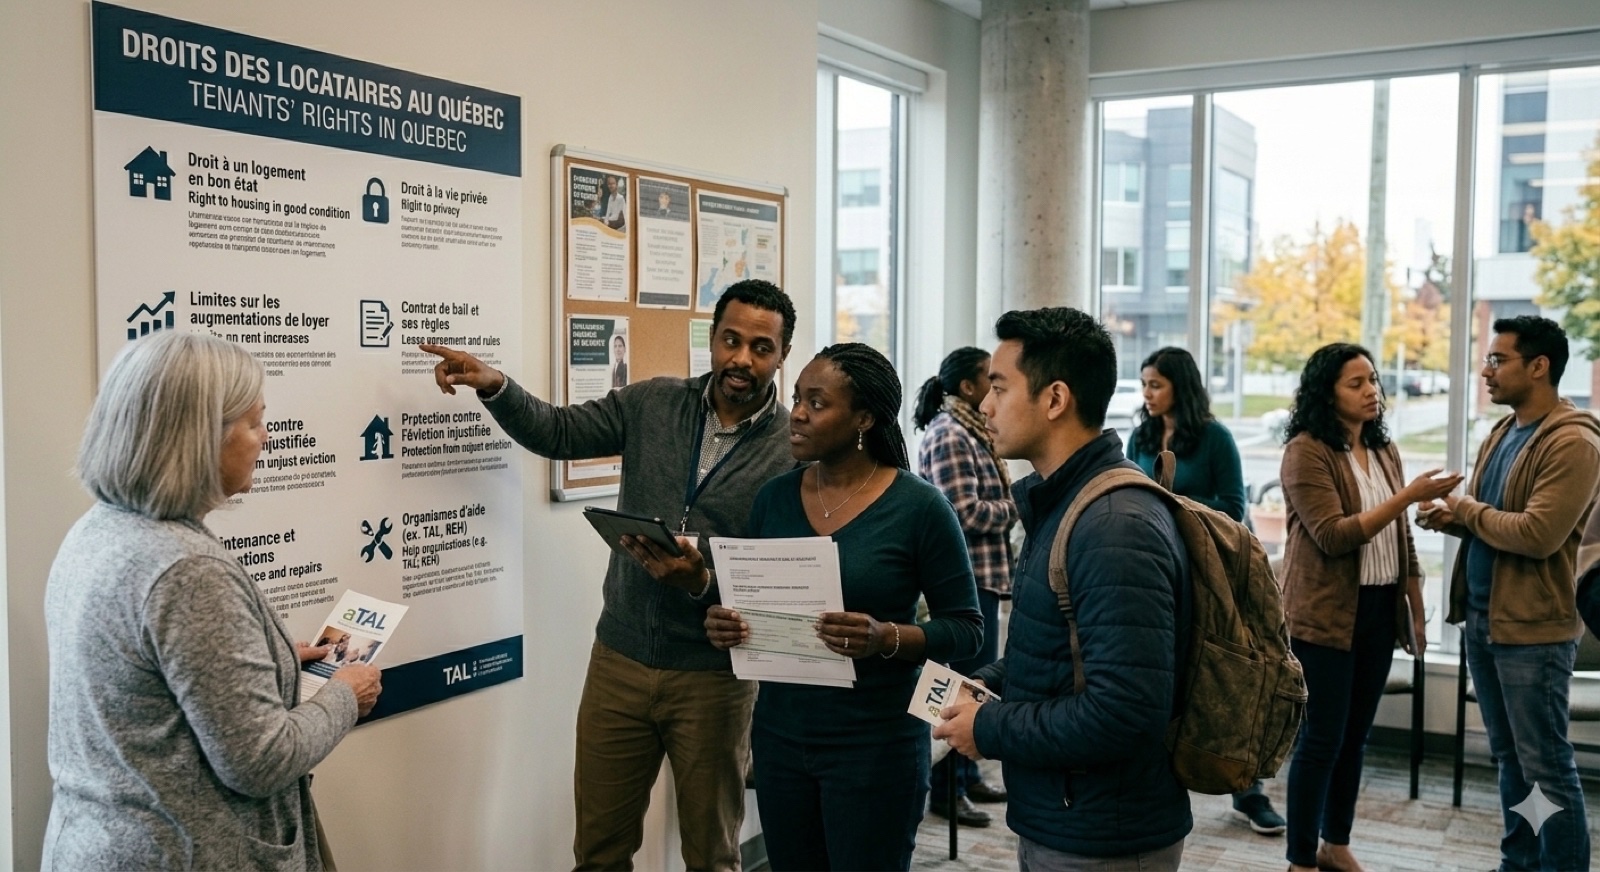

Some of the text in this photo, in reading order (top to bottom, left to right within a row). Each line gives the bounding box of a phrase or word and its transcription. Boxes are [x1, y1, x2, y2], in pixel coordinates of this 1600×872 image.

[122, 28, 504, 130] DROITS DES LOCATAIRES AU QUÉBEC
[188, 80, 467, 152] TENANTS' RIGHTS IN QUEBEC
[188, 152, 306, 181] Droit à un logement
[188, 173, 258, 193] en bon état
[401, 182, 488, 205] Droit à la vie privée
[188, 191, 350, 220] Right to housing in good condition
[424, 202, 431, 212] to
[433, 203, 460, 218] privacy
[190, 291, 280, 309] Limites sur les
[401, 301, 479, 316] Contrat de bail et
[190, 312, 330, 330] augmentations de loyer
[401, 318, 450, 332] ses règles
[241, 332, 261, 343] rent
[263, 332, 309, 344] increases
[467, 335, 481, 346] and
[266, 418, 303, 432] contre
[452, 411, 481, 423] contre
[262, 433, 316, 454] njustifiée
[267, 455, 297, 470] unjust
[299, 452, 336, 466] eviction
[402, 503, 485, 526] Organismes d'aide
[219, 528, 295, 550] ntenance et
[402, 528, 421, 544] (ex.
[423, 525, 443, 538] TAL,
[268, 565, 286, 580] and
[289, 561, 322, 578] repairs
[342, 607, 387, 630] aTAL
[443, 662, 472, 686] TAL
